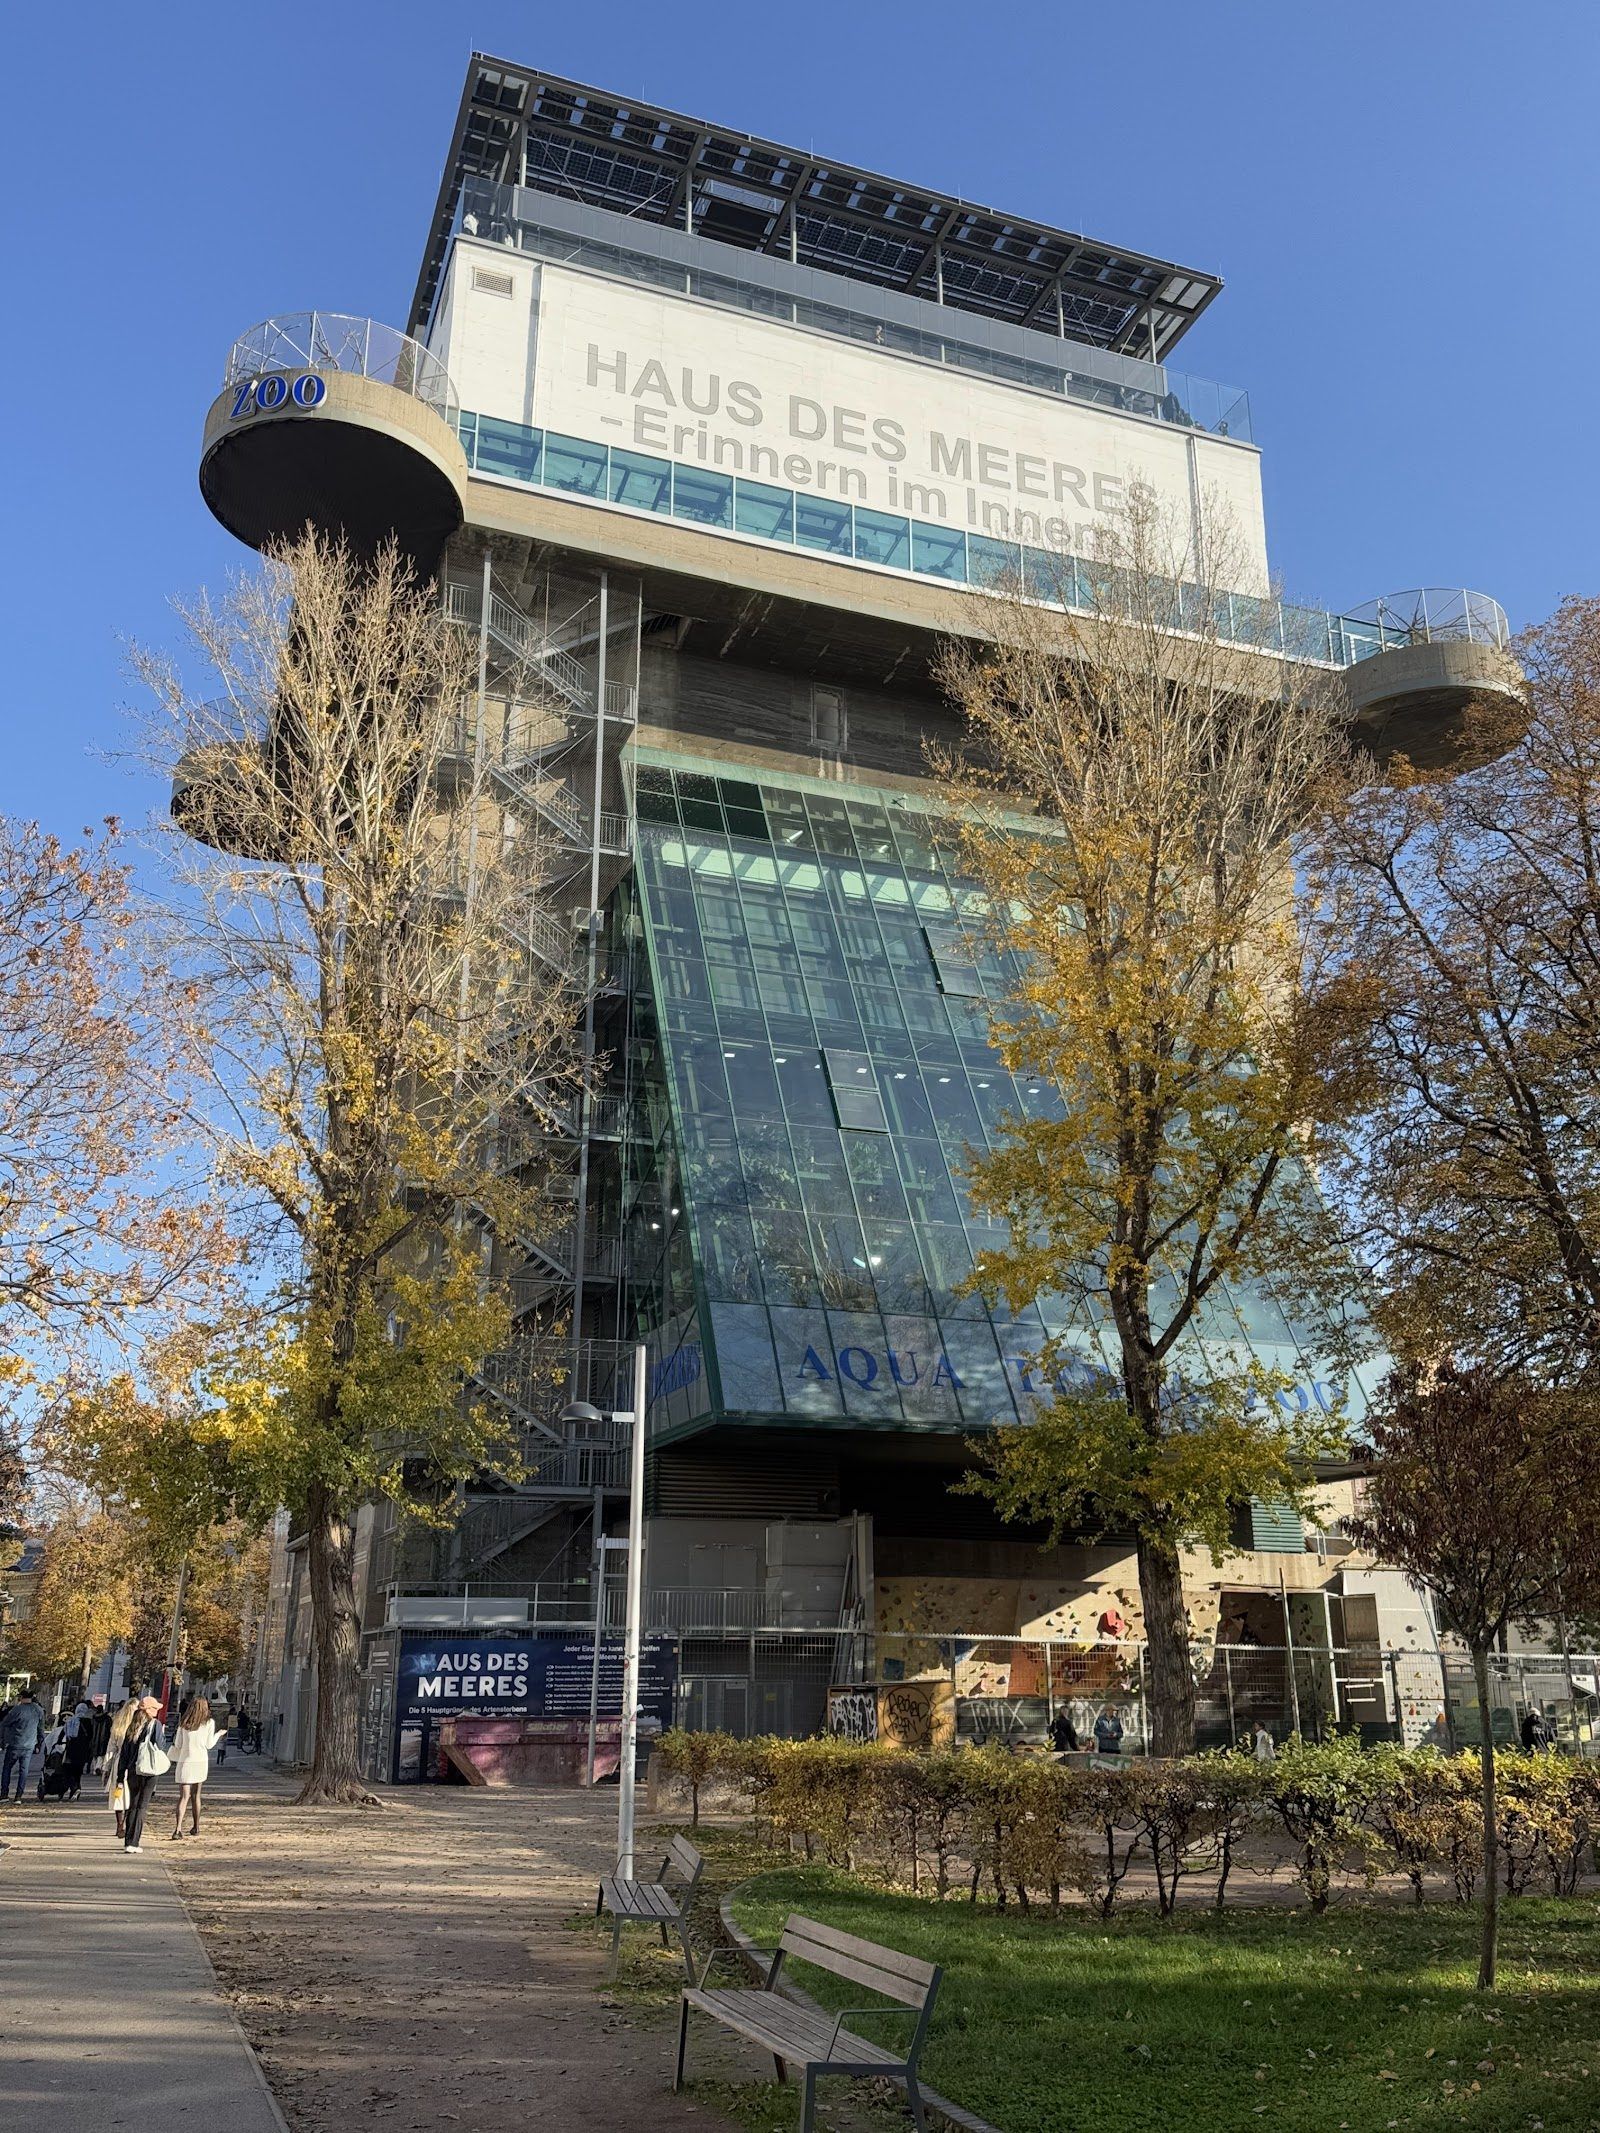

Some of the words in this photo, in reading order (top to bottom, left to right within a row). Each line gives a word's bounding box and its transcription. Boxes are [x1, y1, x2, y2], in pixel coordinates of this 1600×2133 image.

[229, 373, 328, 421] ZOO
[586, 342, 764, 428] HAUS
[788, 394, 907, 463] DES
[930, 430, 1160, 524] MEERES
[888, 466, 947, 518] im
[795, 1343, 968, 1392] AQUA
[417, 1674, 528, 1698] MEERES
[487, 1652, 529, 1672] DES
[408, 1706, 420, 1714] Die
[426, 1706, 468, 1715] Hauptgründ
[482, 1705, 528, 1713] Artensterbens
